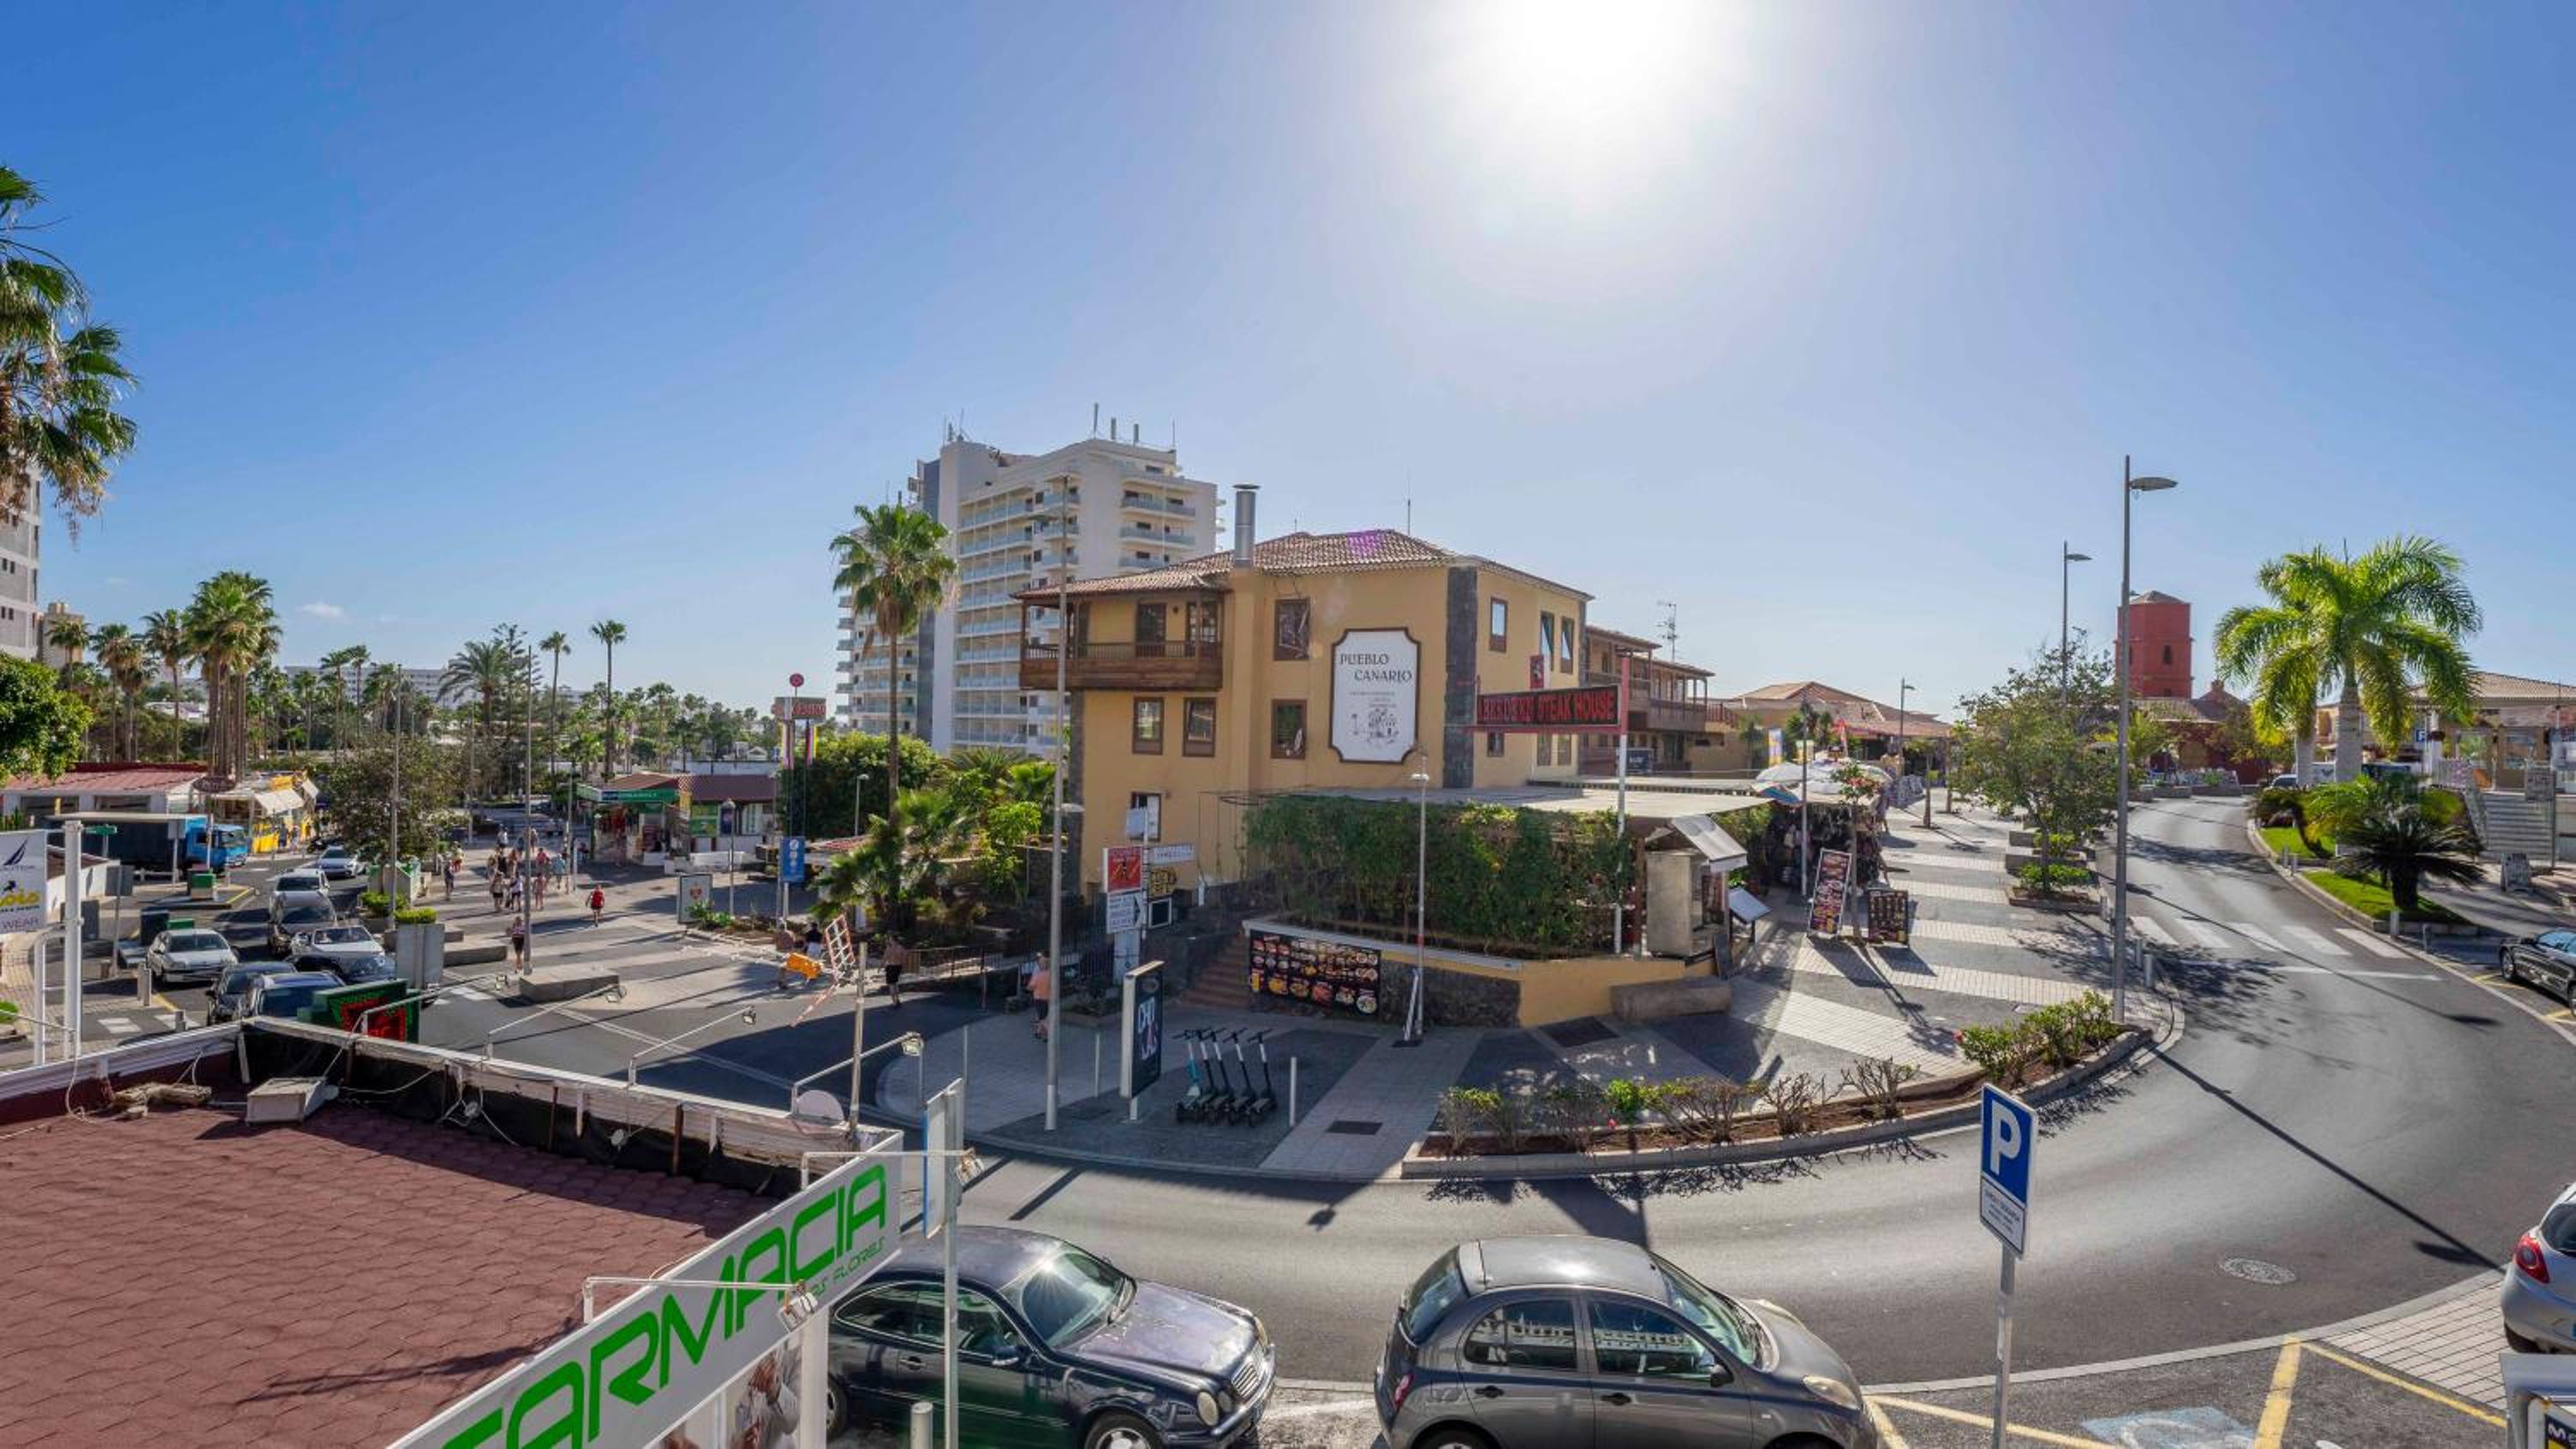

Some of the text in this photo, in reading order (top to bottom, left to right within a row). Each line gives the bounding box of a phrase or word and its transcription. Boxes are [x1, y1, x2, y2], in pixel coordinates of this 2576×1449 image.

[1340, 653, 1390, 665] PUEBLO
[1354, 670, 1413, 683] CANARIO
[1574, 689, 1614, 719] HOUSE
[1990, 1099, 2022, 1176] P
[832, 1236, 886, 1281] FLORES
